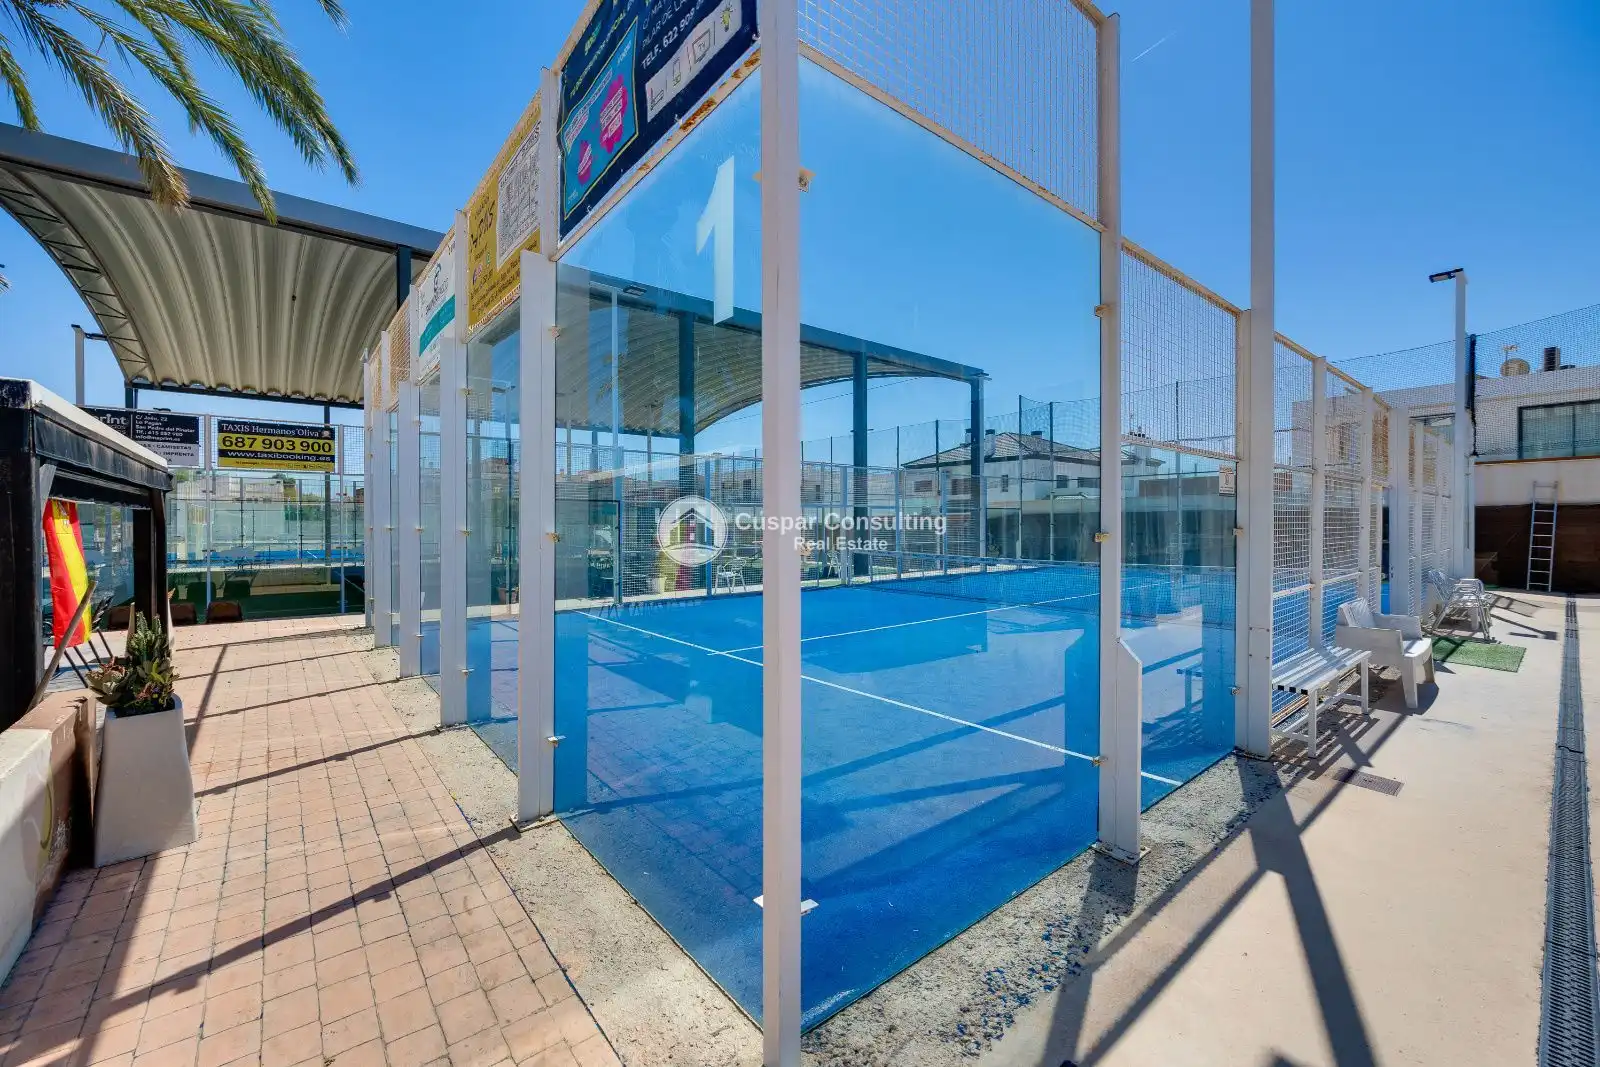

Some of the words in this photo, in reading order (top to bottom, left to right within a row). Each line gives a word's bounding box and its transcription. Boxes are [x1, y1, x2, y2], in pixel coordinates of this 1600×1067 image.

[641, 44, 662, 70] TELF.
[662, 26, 679, 48] 622
[696, 155, 734, 325] 1
[221, 423, 250, 433] TAXIS
[251, 425, 296, 436] Hermanos
[222, 435, 257, 449] 687
[261, 438, 296, 452] 903
[300, 440, 332, 453] 900
[227, 450, 331, 462] www.taxibooking.es
